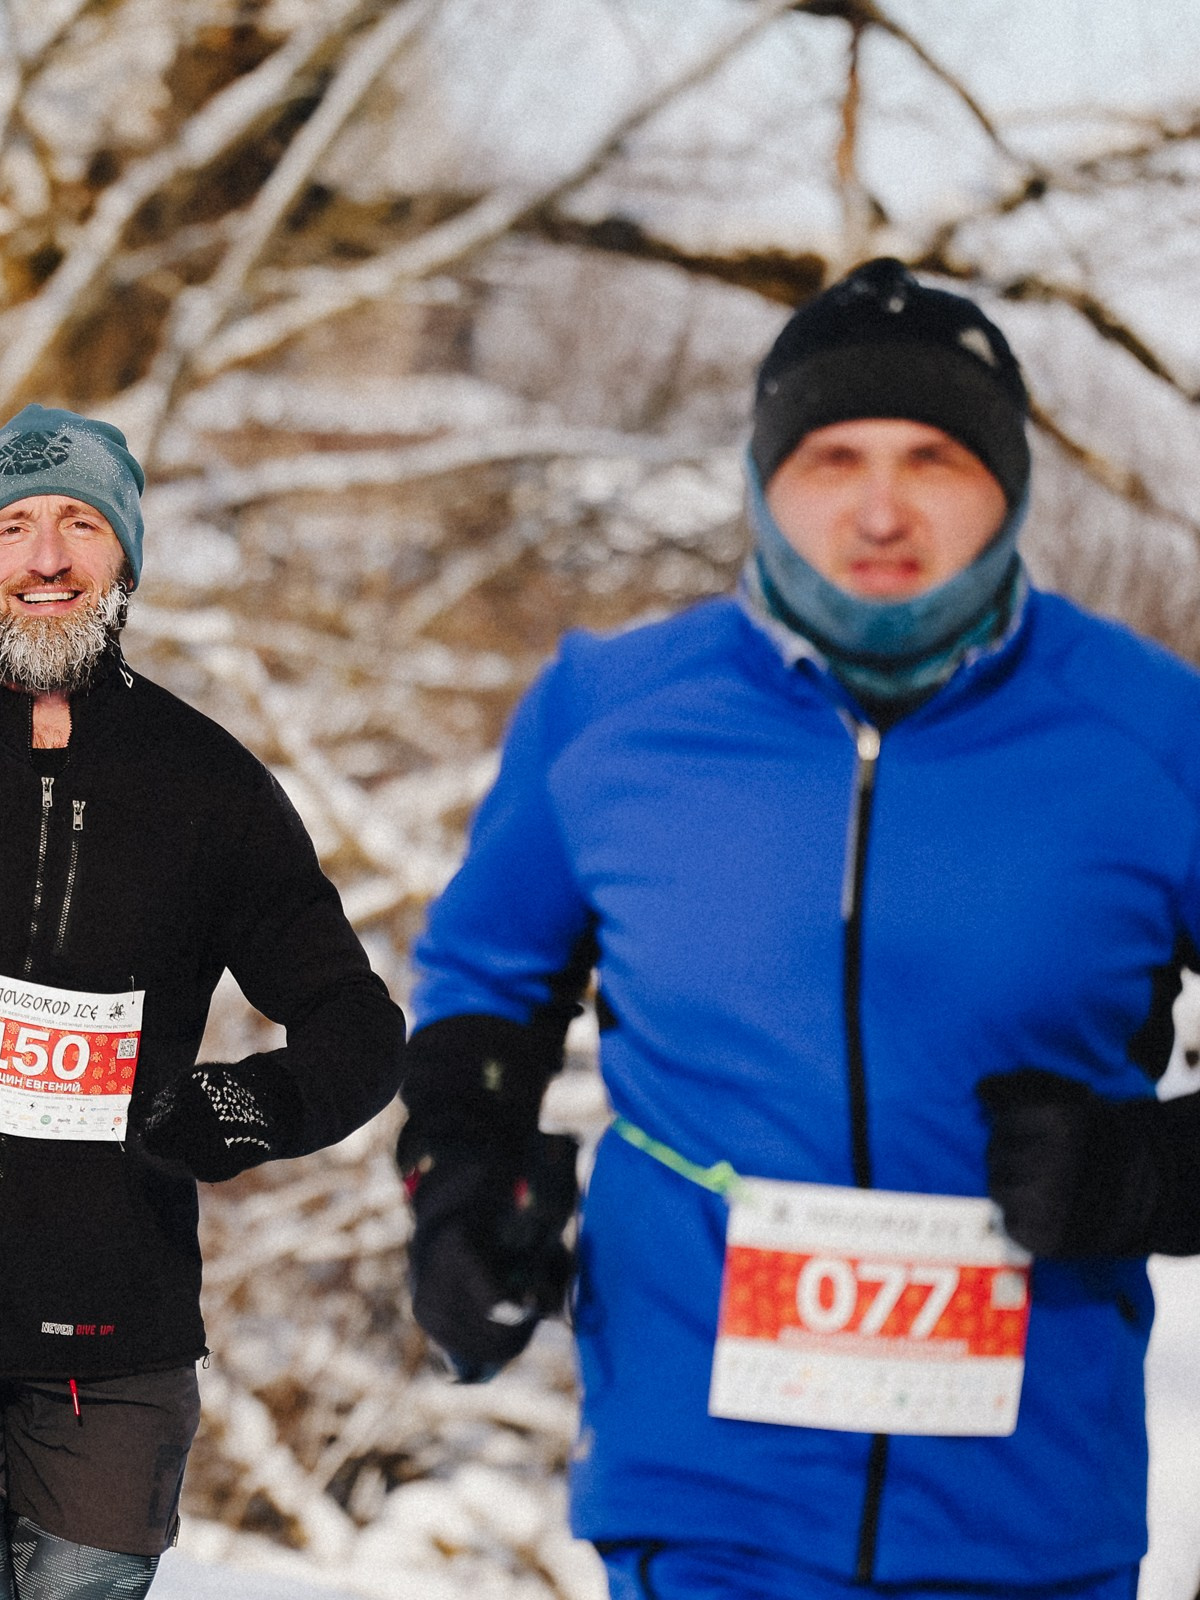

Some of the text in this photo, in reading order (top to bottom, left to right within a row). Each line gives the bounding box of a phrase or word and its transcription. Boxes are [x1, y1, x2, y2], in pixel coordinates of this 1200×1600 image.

[73, 1003, 99, 1021] ICE
[25, 1078, 82, 1093] ЕВГЕНИЙ
[796, 1256, 960, 1337] 077
[41, 1321, 74, 1336] NEVER
